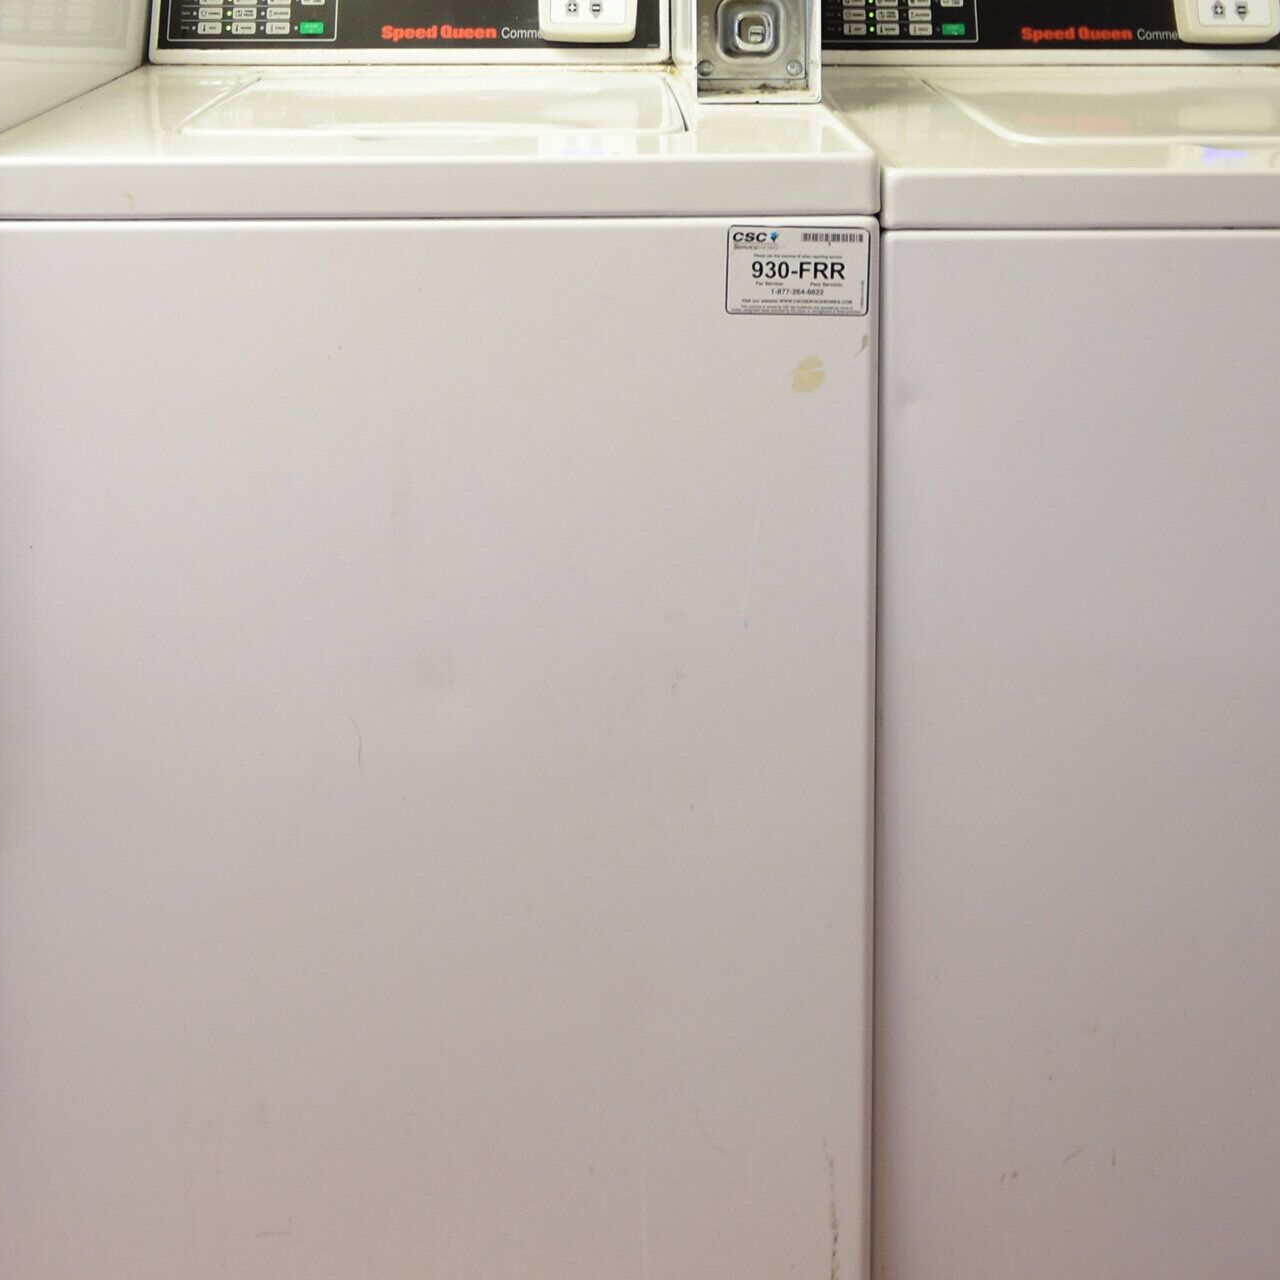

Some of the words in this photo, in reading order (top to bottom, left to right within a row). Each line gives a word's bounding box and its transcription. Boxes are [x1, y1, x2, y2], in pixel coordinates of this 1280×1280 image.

[381, 25, 437, 42] Speed
[441, 25, 497, 39] Queen
[501, 27, 541, 39] Comme
[1021, 26, 1075, 43] Speed
[1079, 26, 1133, 40] Queen
[1137, 28, 1178, 40] Comme
[733, 232, 767, 242] CSC
[752, 261, 845, 280] 930-FRR
